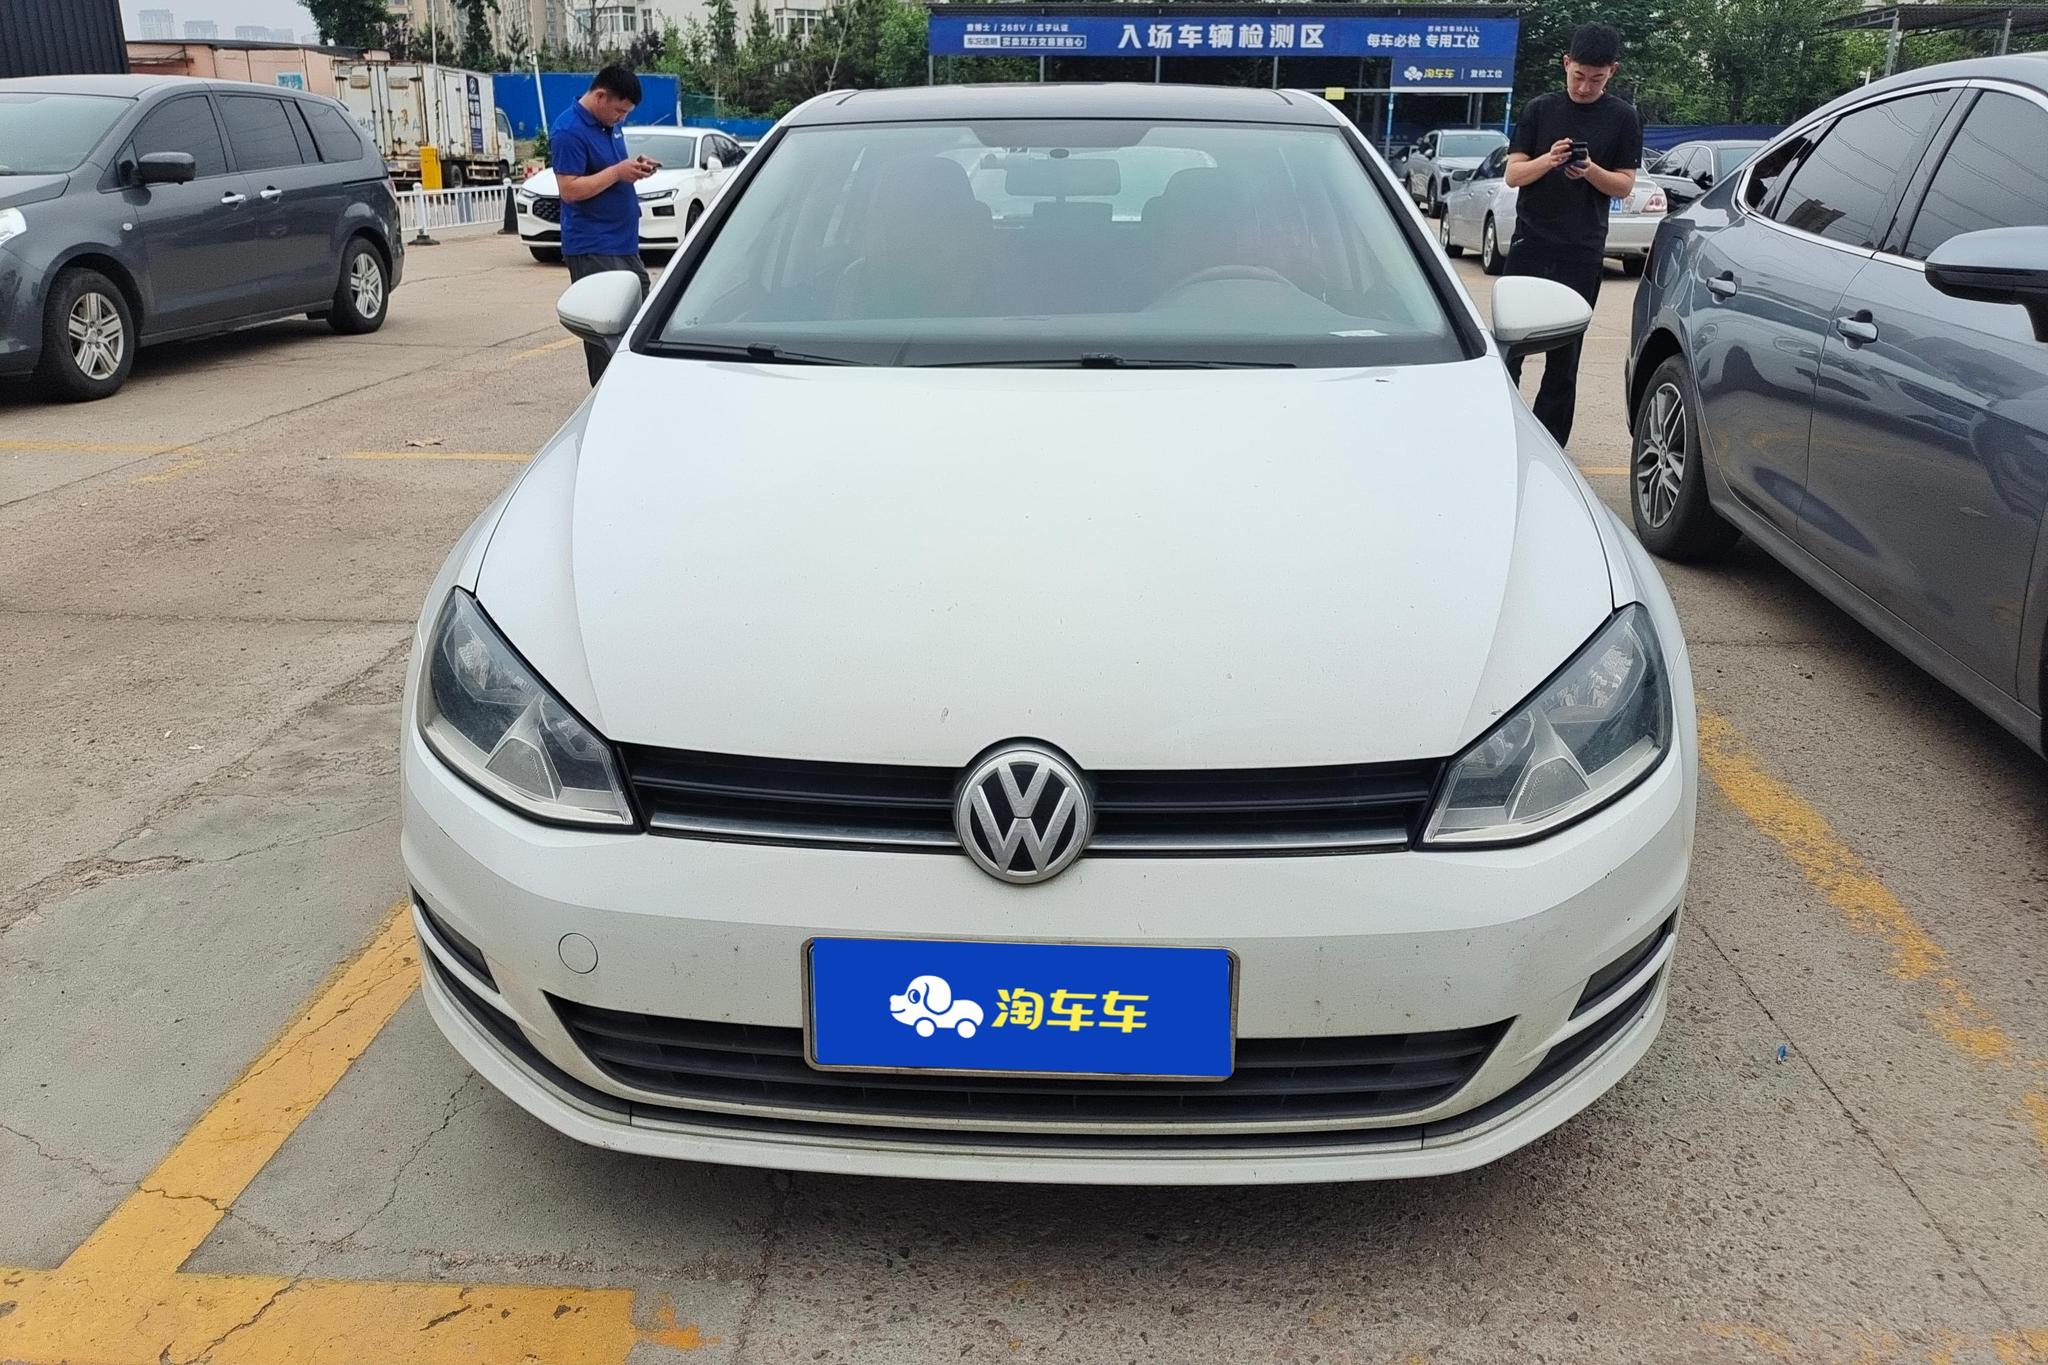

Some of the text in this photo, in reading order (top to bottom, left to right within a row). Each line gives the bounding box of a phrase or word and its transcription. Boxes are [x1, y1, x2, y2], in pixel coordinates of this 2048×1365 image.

[1117, 23, 1326, 49] 入场车辆检测区
[1366, 33, 1480, 48] 每车必检 专用工位
[1423, 68, 1456, 79] 淘车车
